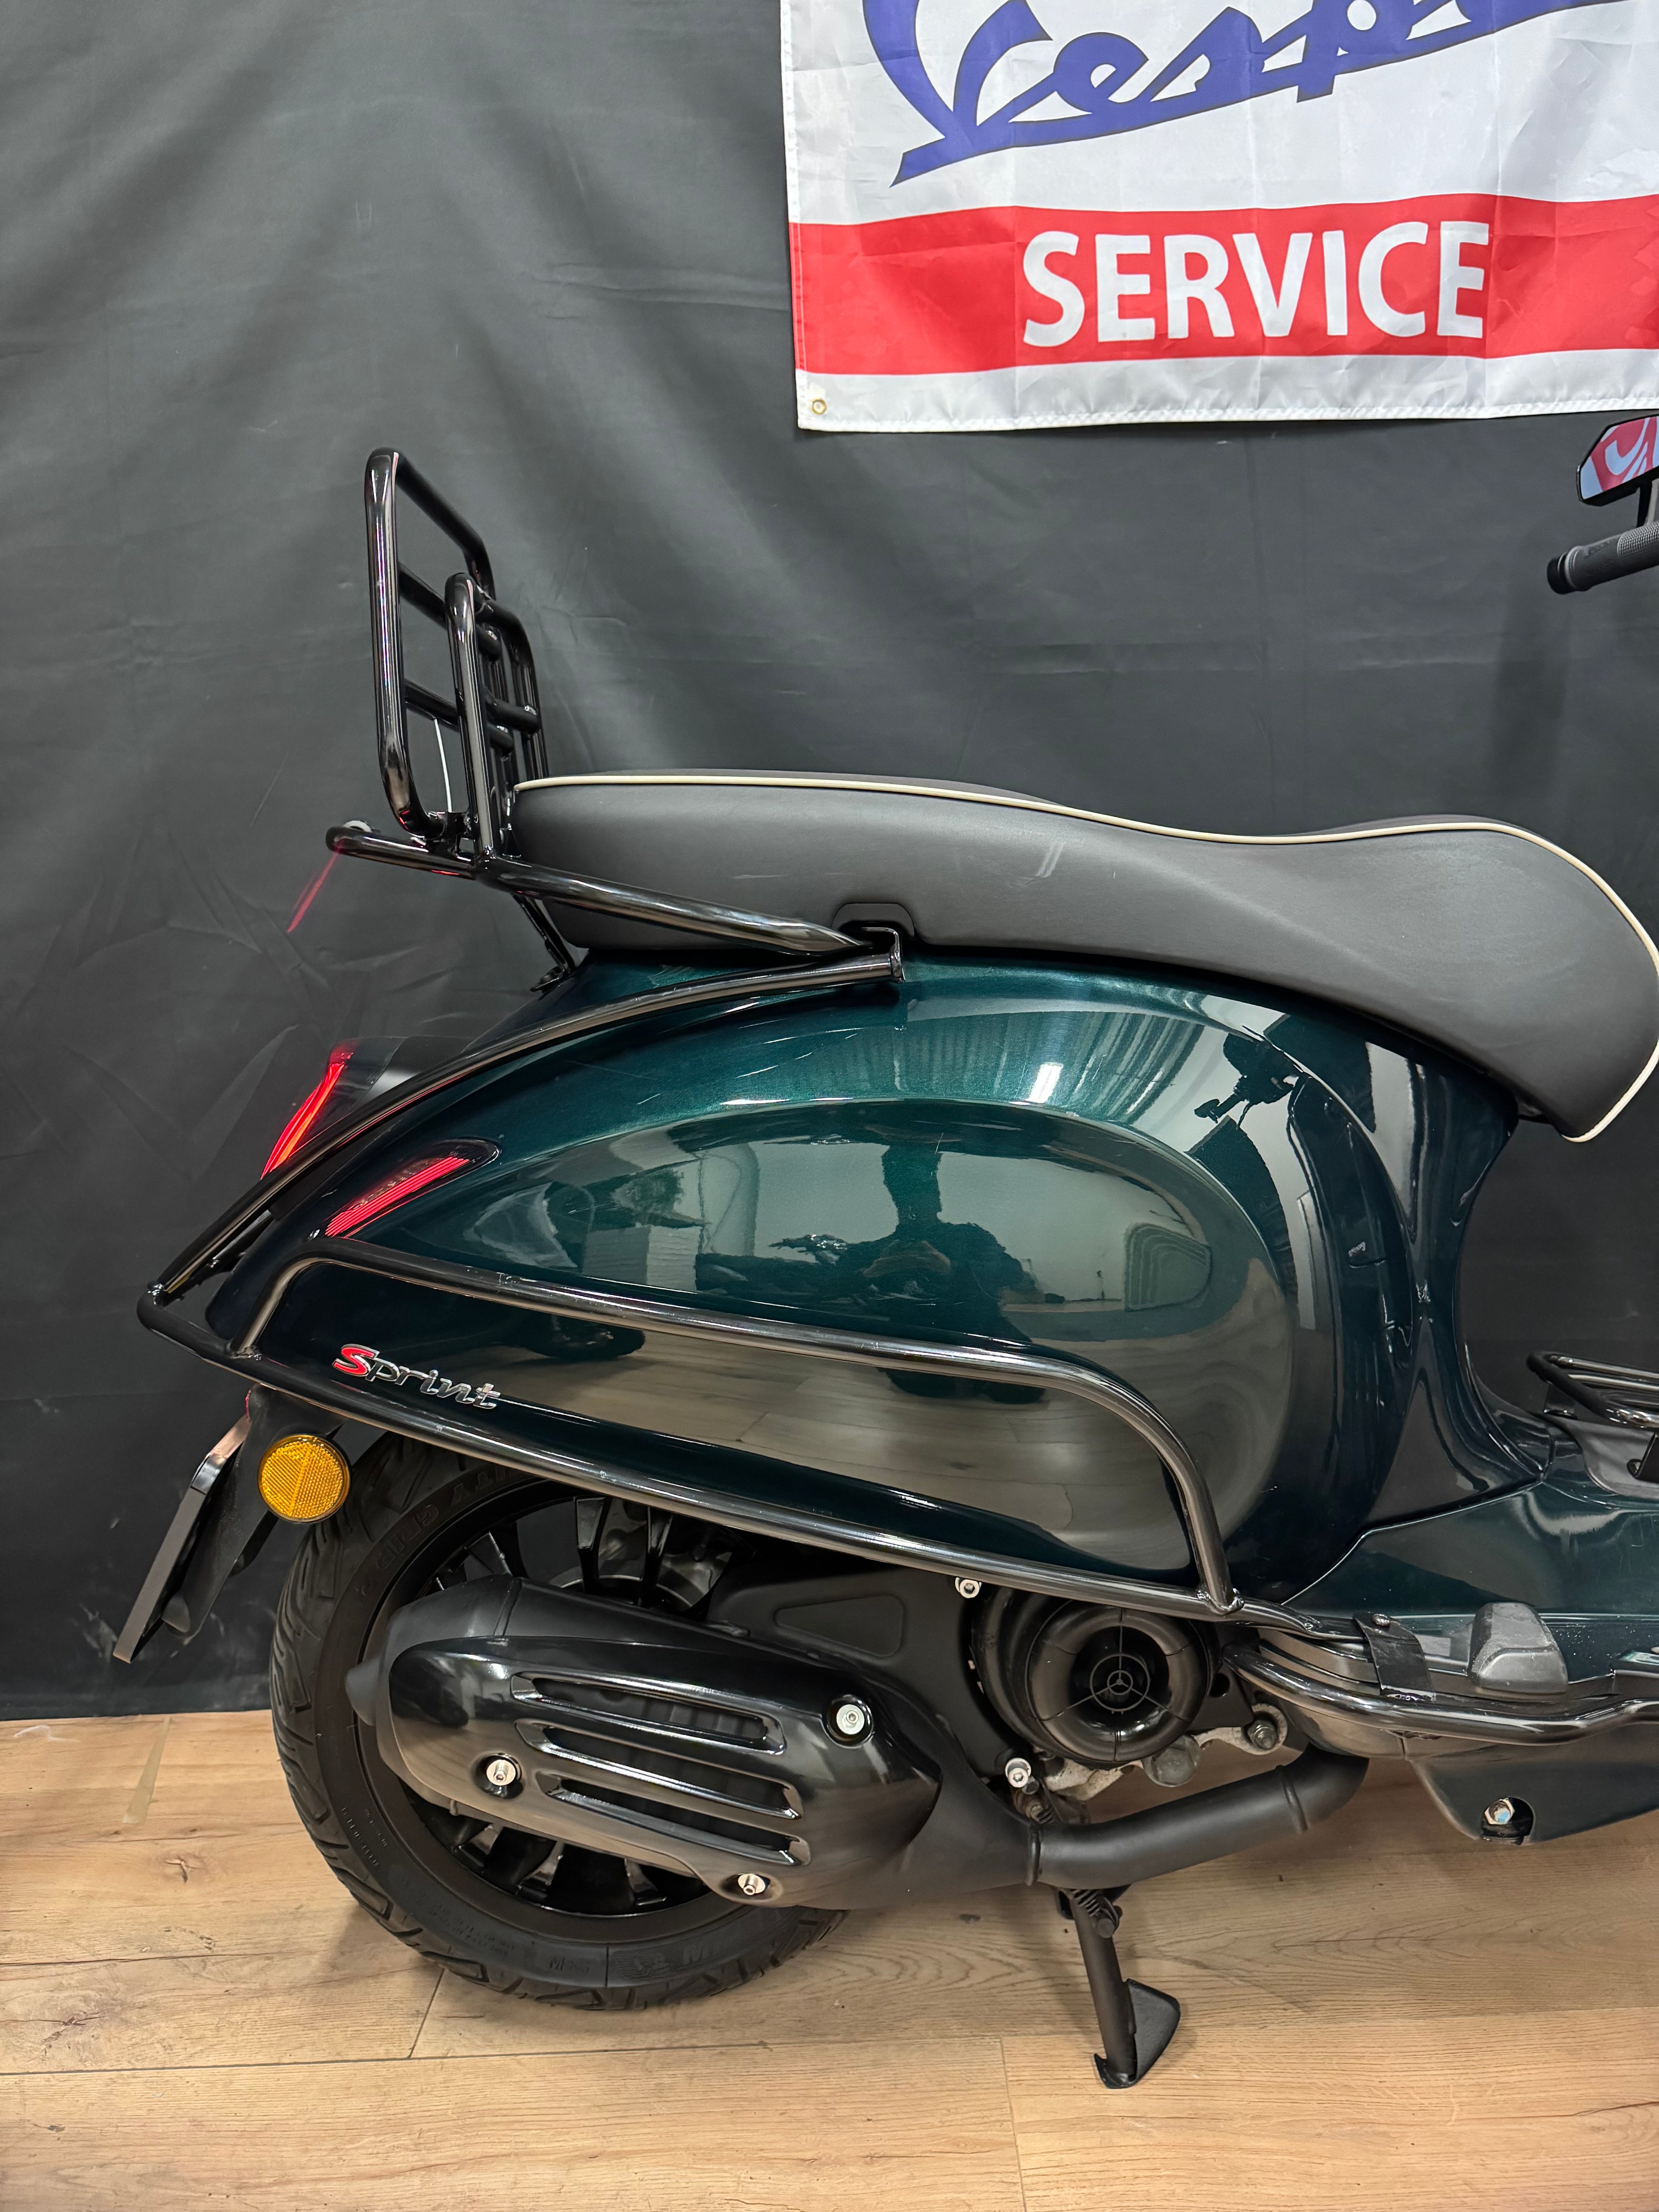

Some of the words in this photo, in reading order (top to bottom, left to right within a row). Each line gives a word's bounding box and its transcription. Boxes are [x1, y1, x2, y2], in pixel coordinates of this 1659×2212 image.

[1023, 221, 1489, 348] SERVICE
[332, 1343, 501, 1409] Sprint
[377, 1504, 439, 1570] GRIP
